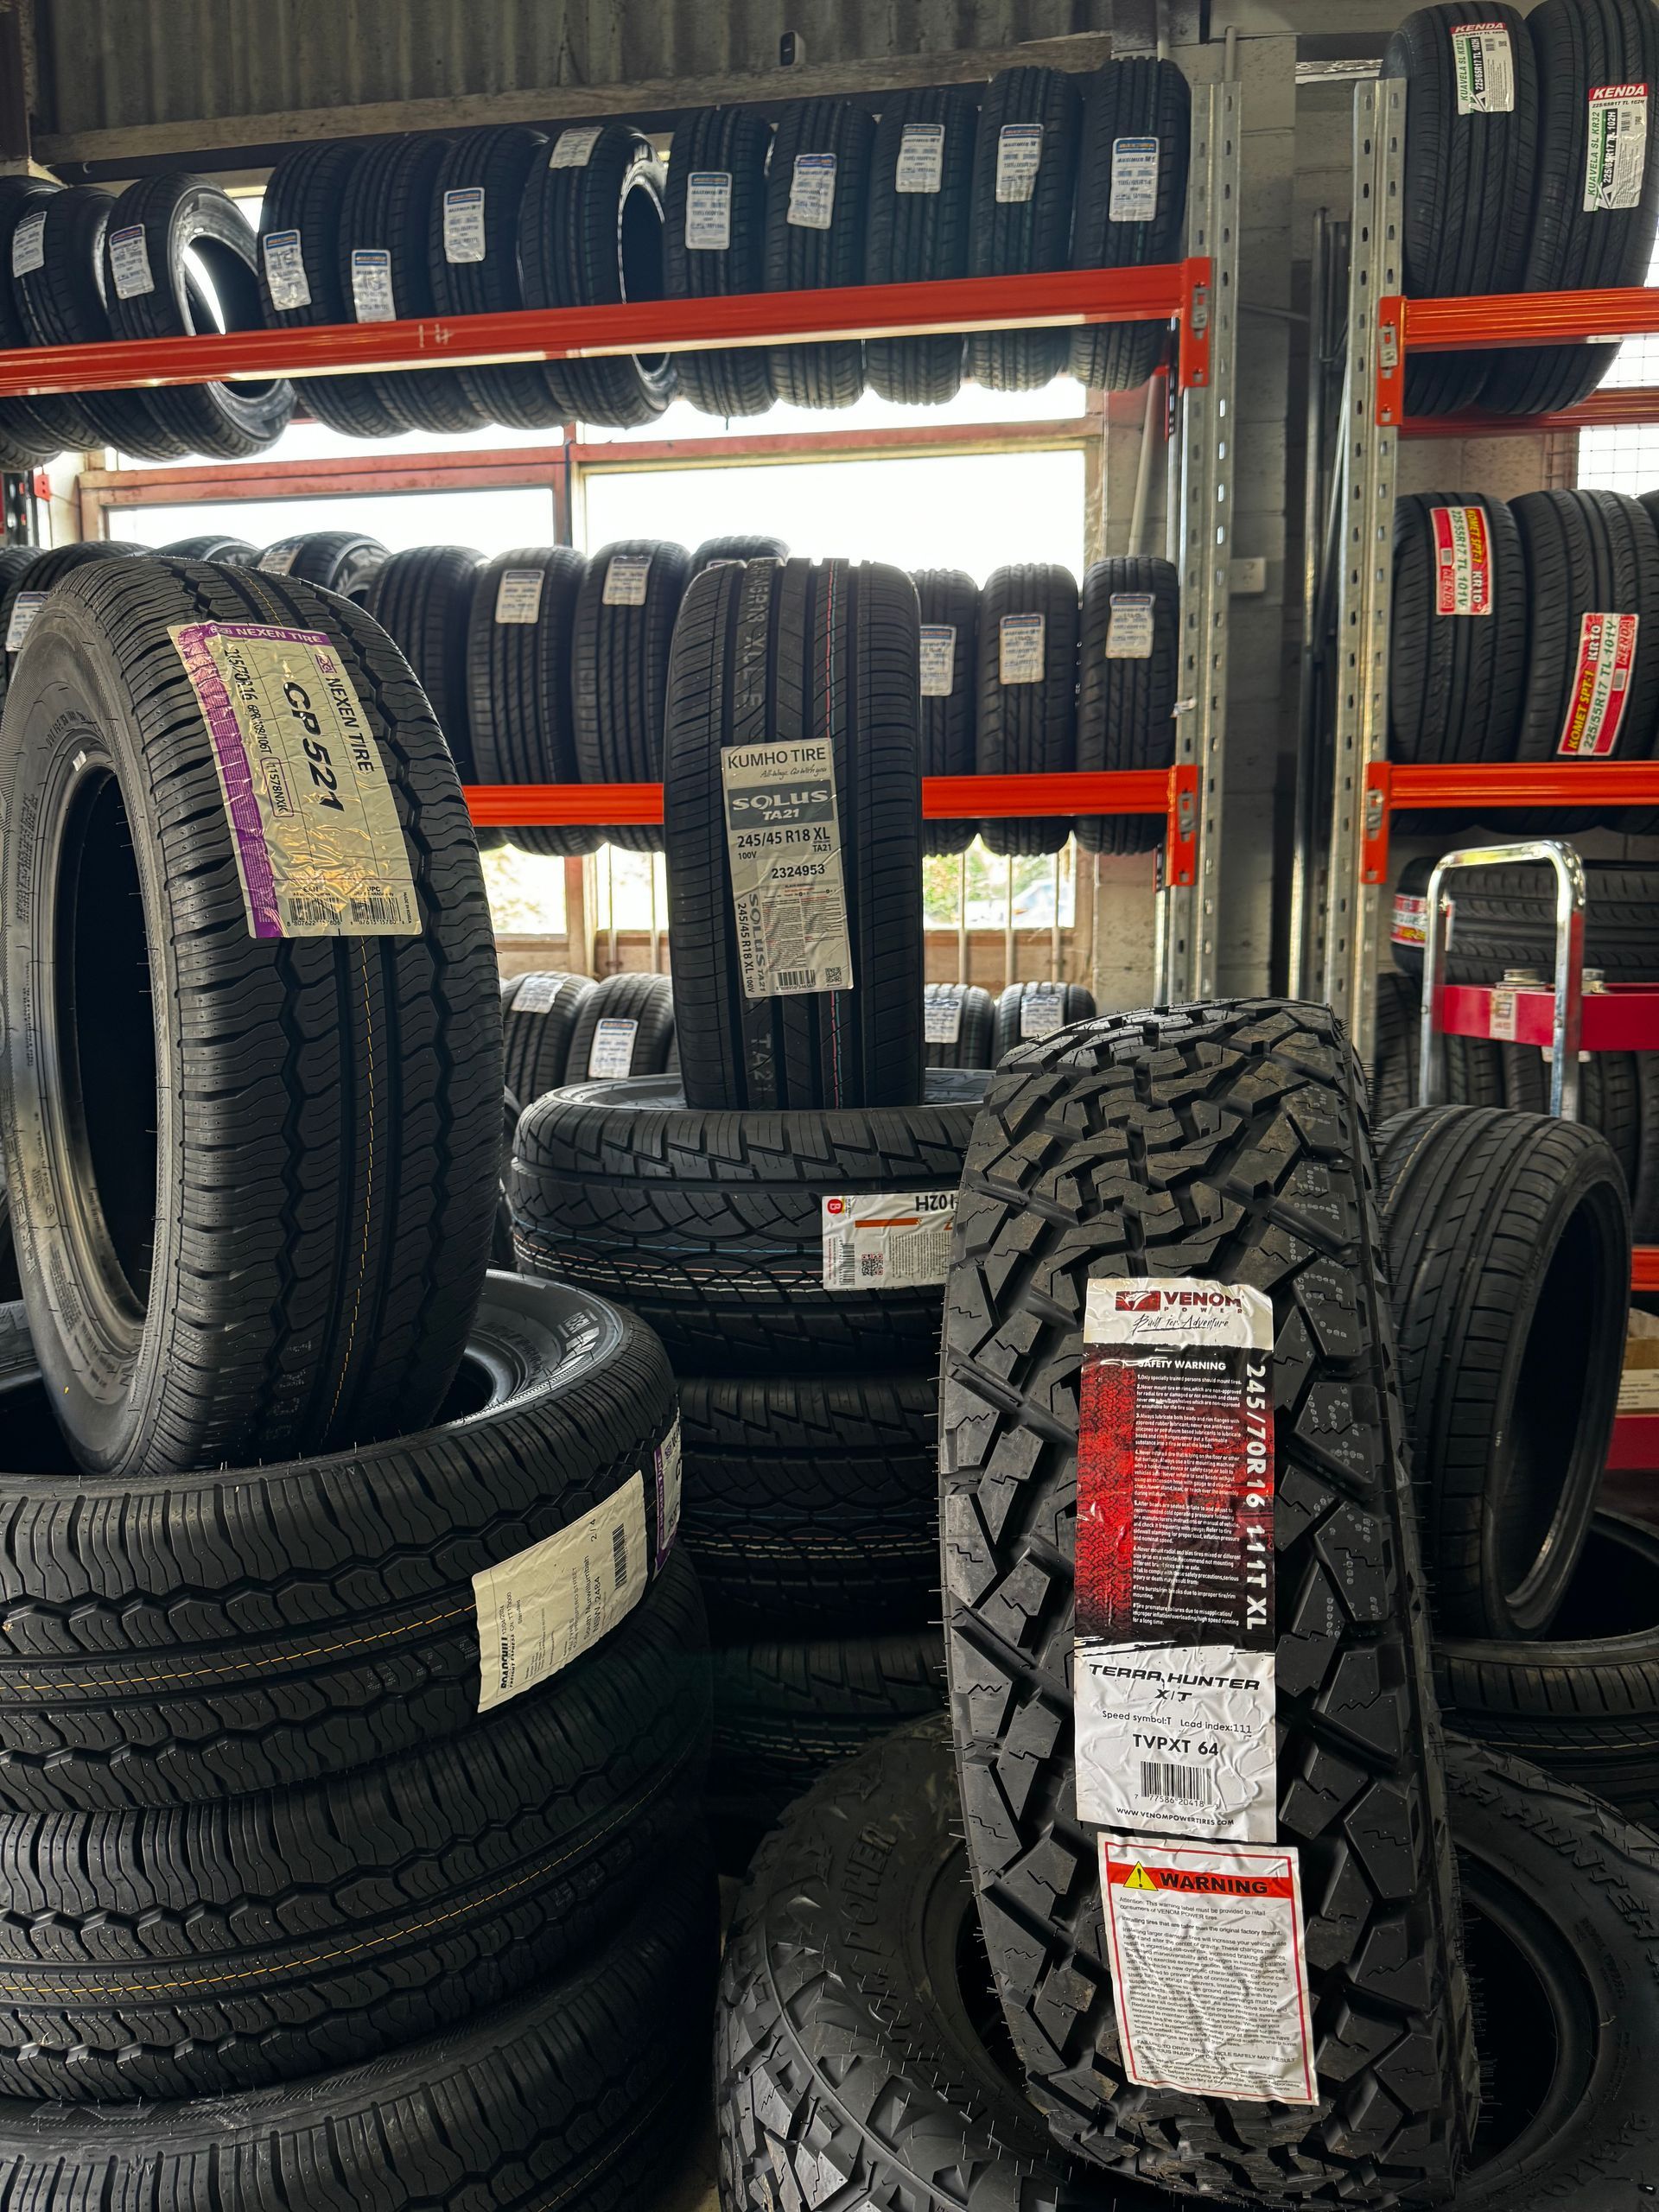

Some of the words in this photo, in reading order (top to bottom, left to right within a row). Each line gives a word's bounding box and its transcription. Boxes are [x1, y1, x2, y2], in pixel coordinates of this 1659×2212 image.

[1455, 22, 1503, 33] KENDA
[1459, 67, 1468, 101] KUAVELA
[1592, 86, 1644, 99] KENDA
[1592, 111, 1600, 134] KR32
[1607, 111, 1616, 130] 102H
[1591, 137, 1599, 149] SL
[1588, 152, 1598, 196] KUAVELA
[1457, 558, 1467, 571] TL
[1442, 569, 1453, 608] KENDA
[1457, 576, 1467, 606] 101V
[1471, 571, 1483, 603] KR10
[236, 628, 286, 639] NEXEN
[290, 632, 323, 643] TIRE
[1587, 625, 1601, 662] KR10
[1617, 620, 1633, 665] KENDA
[1583, 682, 1608, 749] 225/55R17
[1599, 661, 1611, 676] TL
[326, 677, 359, 728] NEXEN
[348, 733, 374, 772] TIRE
[1567, 704, 1586, 749] KOMET
[283, 681, 321, 735] CP
[302, 738, 345, 811] 521
[728, 750, 788, 769] KUMHO
[791, 747, 826, 762] TIRE
[267, 763, 289, 813] 11578NXK
[733, 790, 829, 810] SOLUS
[763, 808, 799, 820] TA21
[737, 831, 782, 849] 245/45
[785, 829, 810, 843] R18
[814, 827, 830, 841] XL
[812, 843, 831, 853] TA21
[738, 851, 757, 860] 100V
[772, 864, 825, 879] 2324953
[738, 903, 750, 939] 245/45
[749, 893, 766, 966] SOLUS
[741, 941, 753, 959] R18
[744, 961, 754, 974] XL
[746, 976, 755, 993] 100V
[757, 969, 766, 991] TA21
[1163, 1291, 1242, 1307] VENOM
[1132, 1313, 1162, 1336] Built
[1181, 1315, 1229, 1330] Adventure
[1139, 1360, 1172, 1369] SAFETY
[1174, 1360, 1226, 1370] WARNING
[1246, 1363, 1267, 1509] 245/70R16
[1246, 1524, 1267, 1588] 111T
[583, 1555, 592, 1613] Murwillumbah
[1246, 1597, 1267, 1630] XL
[583, 1613, 592, 1640] South
[1089, 1663, 1162, 1681] TERRA
[1166, 1673, 1261, 1691] HUNTER
[1102, 1711, 1130, 1721] Speed
[1133, 1714, 1172, 1726] symbol:T
[1180, 1719, 1202, 1729] Load
[1205, 1721, 1252, 1734] index:111
[1133, 1733, 1192, 1753] TVPXT
[1198, 1741, 1219, 1756] 64
[1149, 1795, 1175, 1804] 77586
[1178, 1798, 1205, 1808] 20418
[1160, 1872, 1268, 1894] WARNING
[1120, 1904, 1150, 1913] consumers
[1180, 1910, 1204, 1919] POWER
[1159, 1902, 1180, 1910] warning
[1146, 1918, 1159, 1927] tires
[1219, 1927, 1240, 1936] original
[1241, 1928, 1260, 1936] factory
